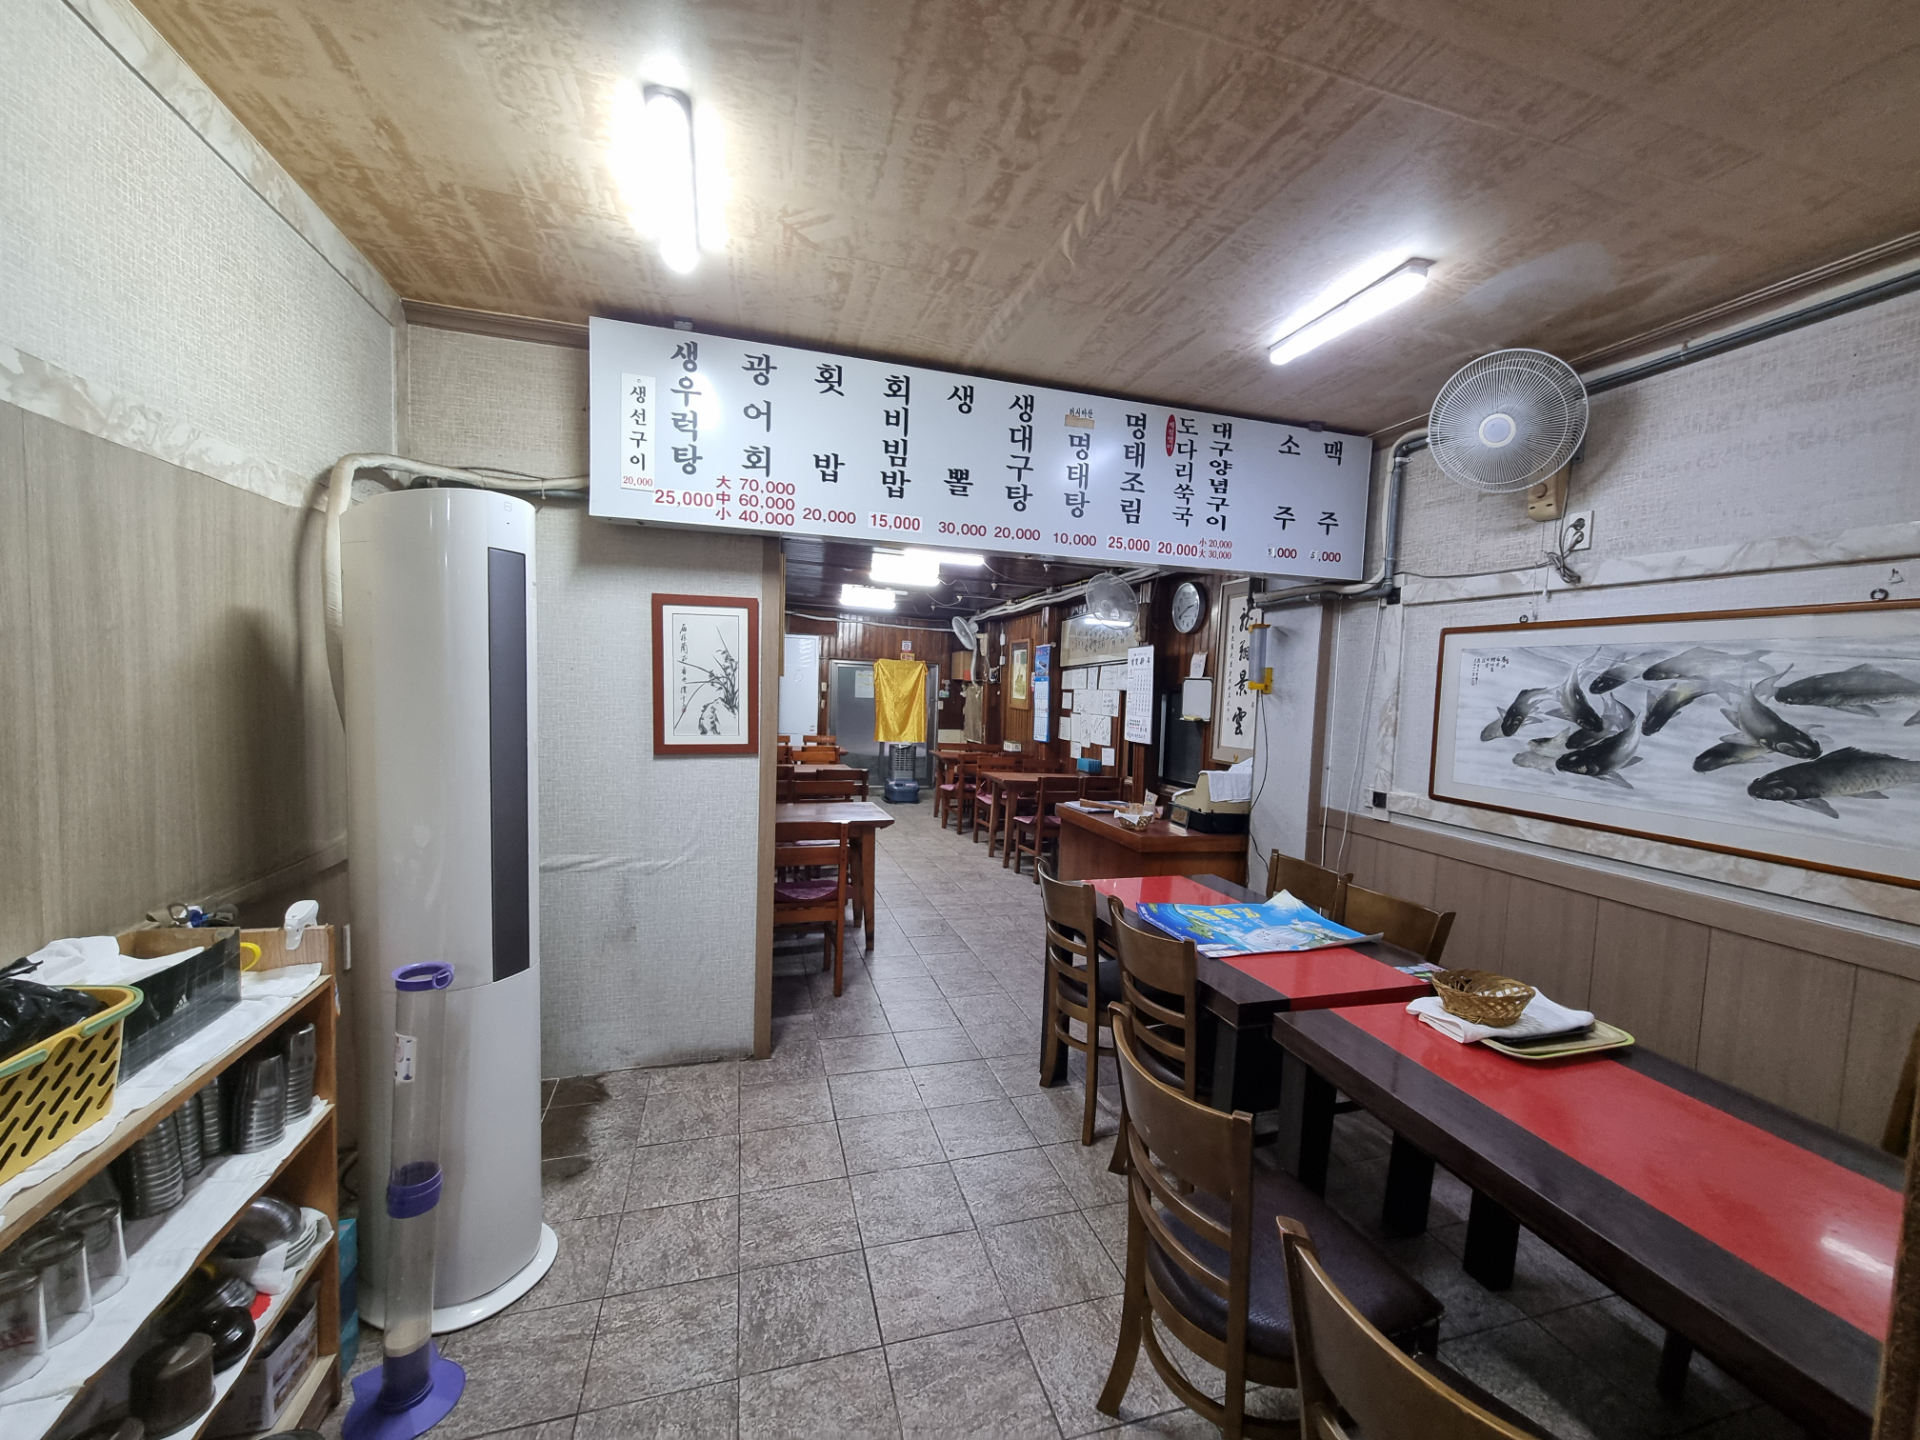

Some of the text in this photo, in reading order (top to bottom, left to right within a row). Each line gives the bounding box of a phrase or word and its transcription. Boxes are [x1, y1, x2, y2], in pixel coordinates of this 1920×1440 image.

[670, 340, 703, 475] 생우럭탕
[741, 353, 778, 478] 광어회
[629, 385, 648, 472] 생선구이
[881, 374, 911, 500] 회비빔밥
[1005, 394, 1035, 512] 생대구탕
[1064, 433, 1091, 519] 명태탕
[1120, 413, 1147, 525] 명태조림
[1171, 417, 1198, 527] 도다리쑥국
[1206, 423, 1233, 532] 대구양념구이
[716, 475, 796, 496] 大 70,000
[654, 489, 714, 508] 25,000
[716, 491, 796, 511] 中 60,000
[716, 507, 795, 526] 小 40,000
[802, 507, 857, 525] 20,000
[871, 514, 921, 531] 15,000
[938, 521, 987, 537] 30,000
[994, 526, 1041, 541] 20,000
[1053, 532, 1097, 547] 10,000
[1108, 536, 1151, 552] 25,000
[1157, 541, 1198, 557] 20,000
[1199, 537, 1233, 549] 小 20,000
[1198, 548, 1232, 560] 大 30,000
